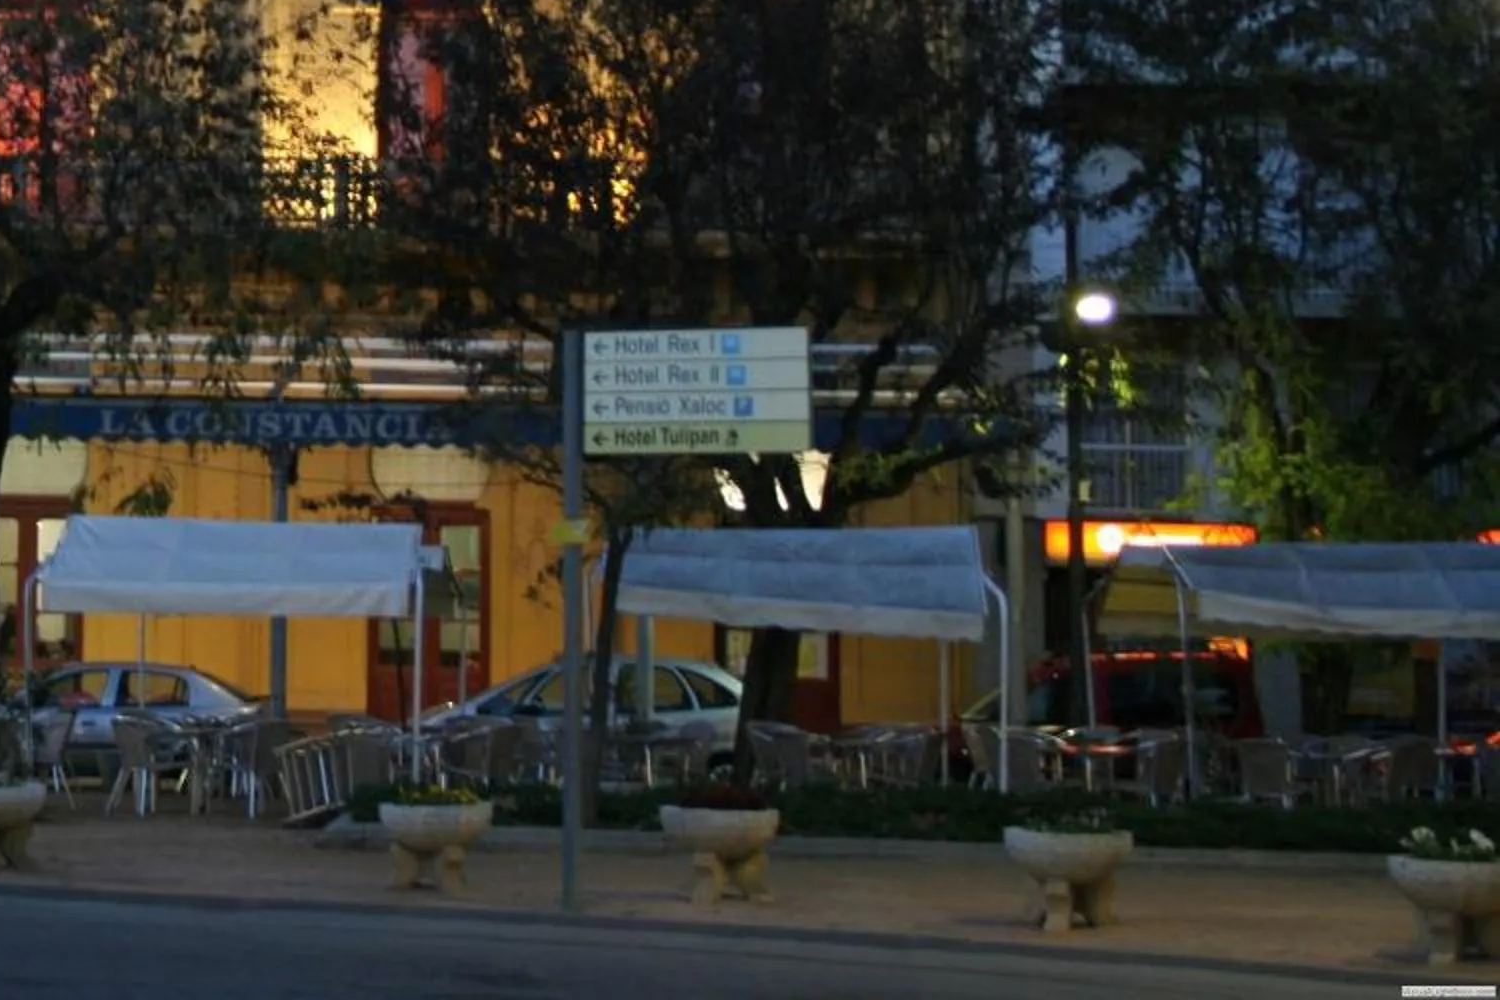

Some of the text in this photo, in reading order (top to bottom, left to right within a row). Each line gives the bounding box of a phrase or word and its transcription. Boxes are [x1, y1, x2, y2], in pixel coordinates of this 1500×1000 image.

[614, 335, 659, 353] Hotel
[668, 333, 700, 352] Rex
[614, 365, 659, 384] Hotel
[668, 364, 700, 383] Rex
[100, 408, 156, 435] LA
[614, 427, 719, 448] Hotel Tulipan
